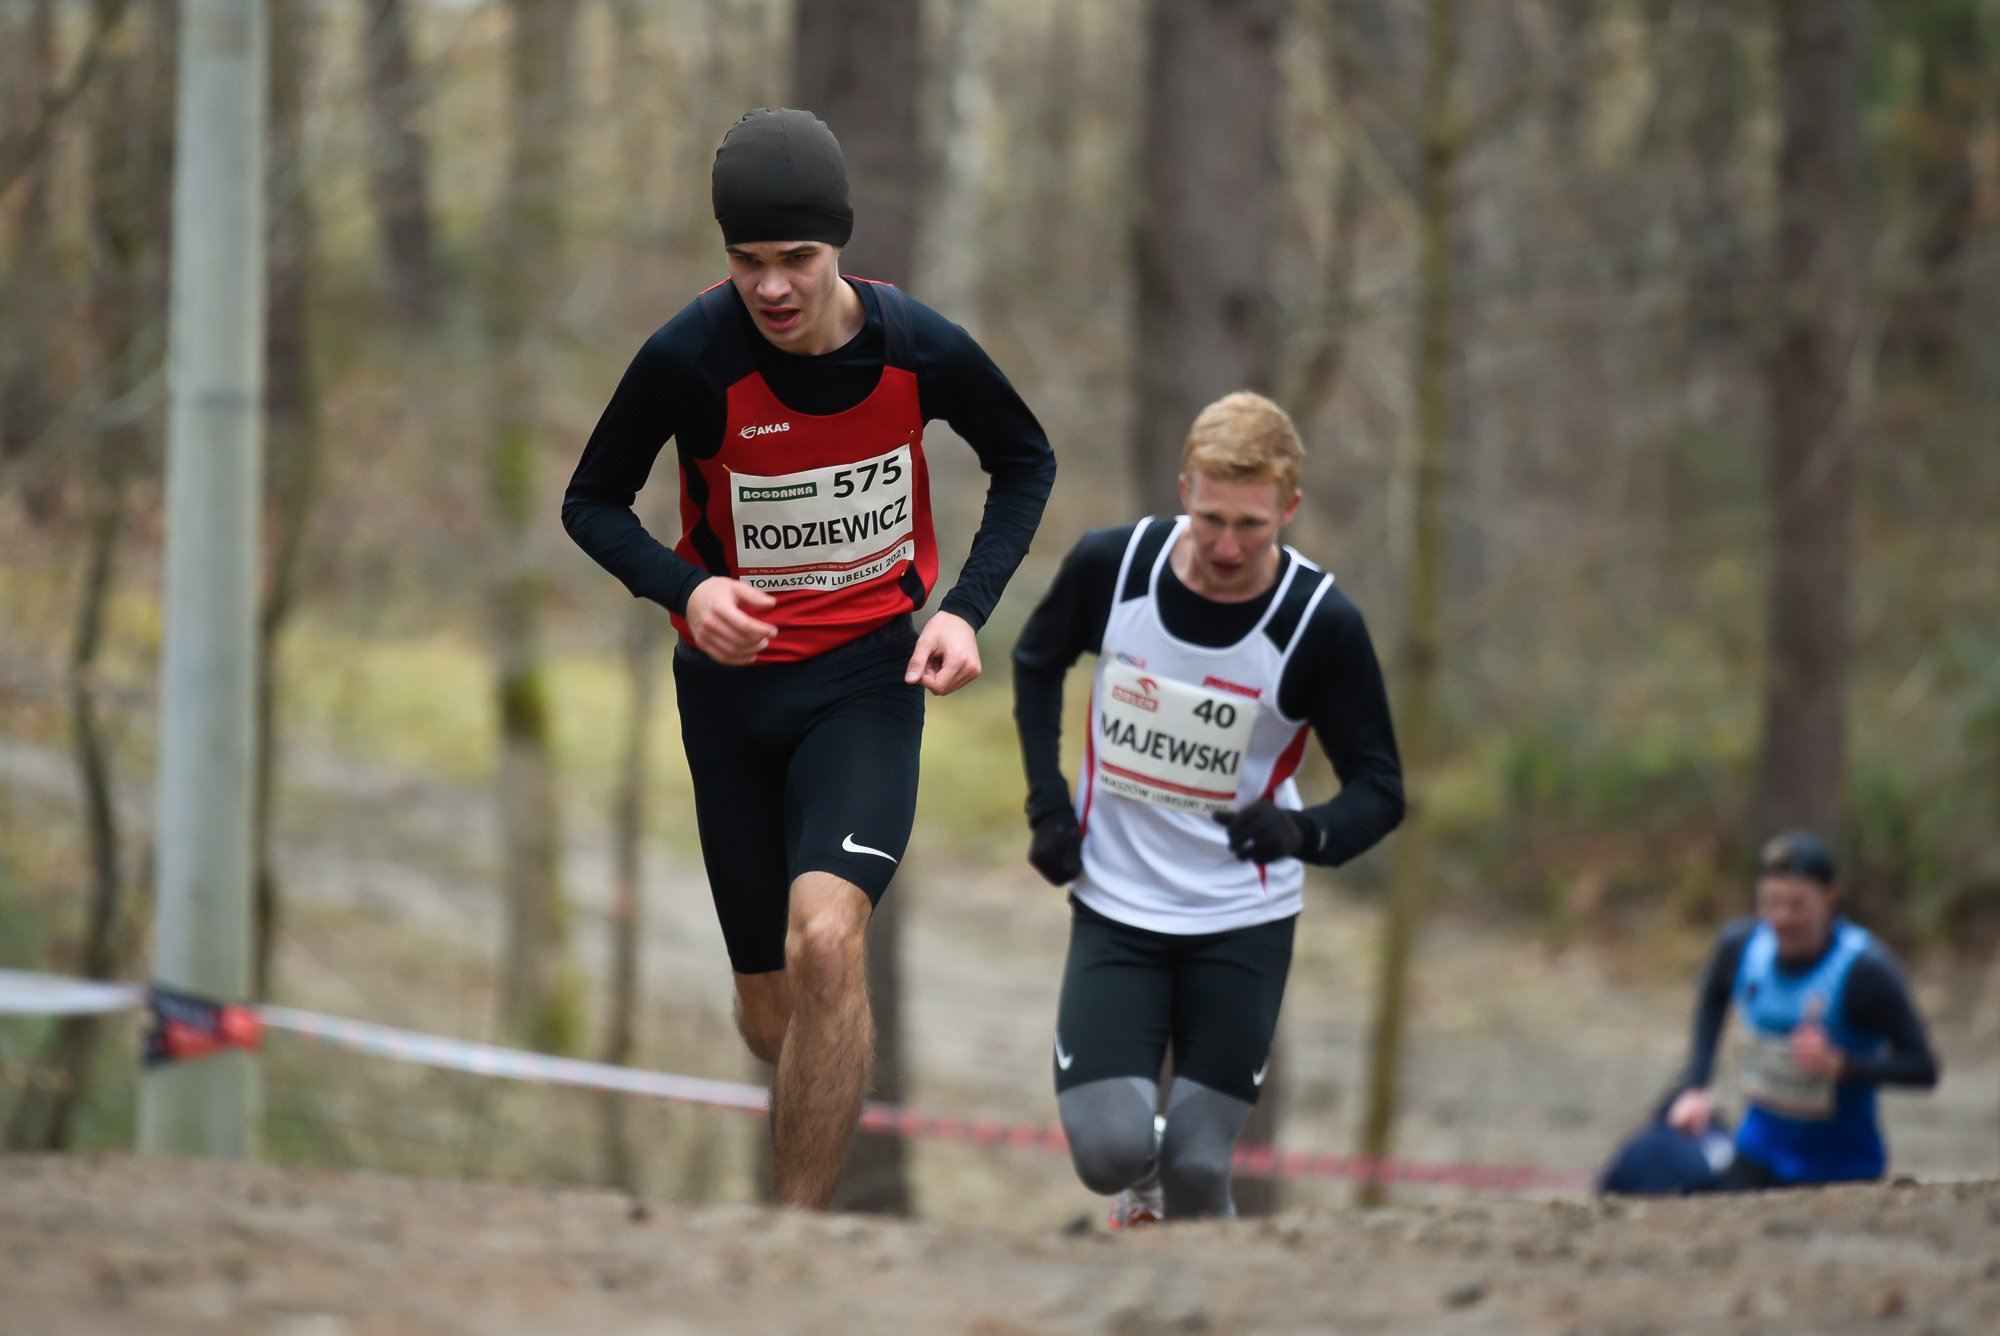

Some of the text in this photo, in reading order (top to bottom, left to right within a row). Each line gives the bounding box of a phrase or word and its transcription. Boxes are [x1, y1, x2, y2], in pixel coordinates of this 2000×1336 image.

[757, 422, 790, 436] AKAS
[742, 454, 903, 500] BOGDANKA 575
[742, 495, 908, 550] RODZIEWICZ
[749, 546, 907, 589] TOMASZÓW LUBELSKI 2021
[1192, 698, 1237, 729] 40
[1100, 711, 1241, 776] MAJEWSKI
[1101, 774, 1149, 798] MASZÓW
